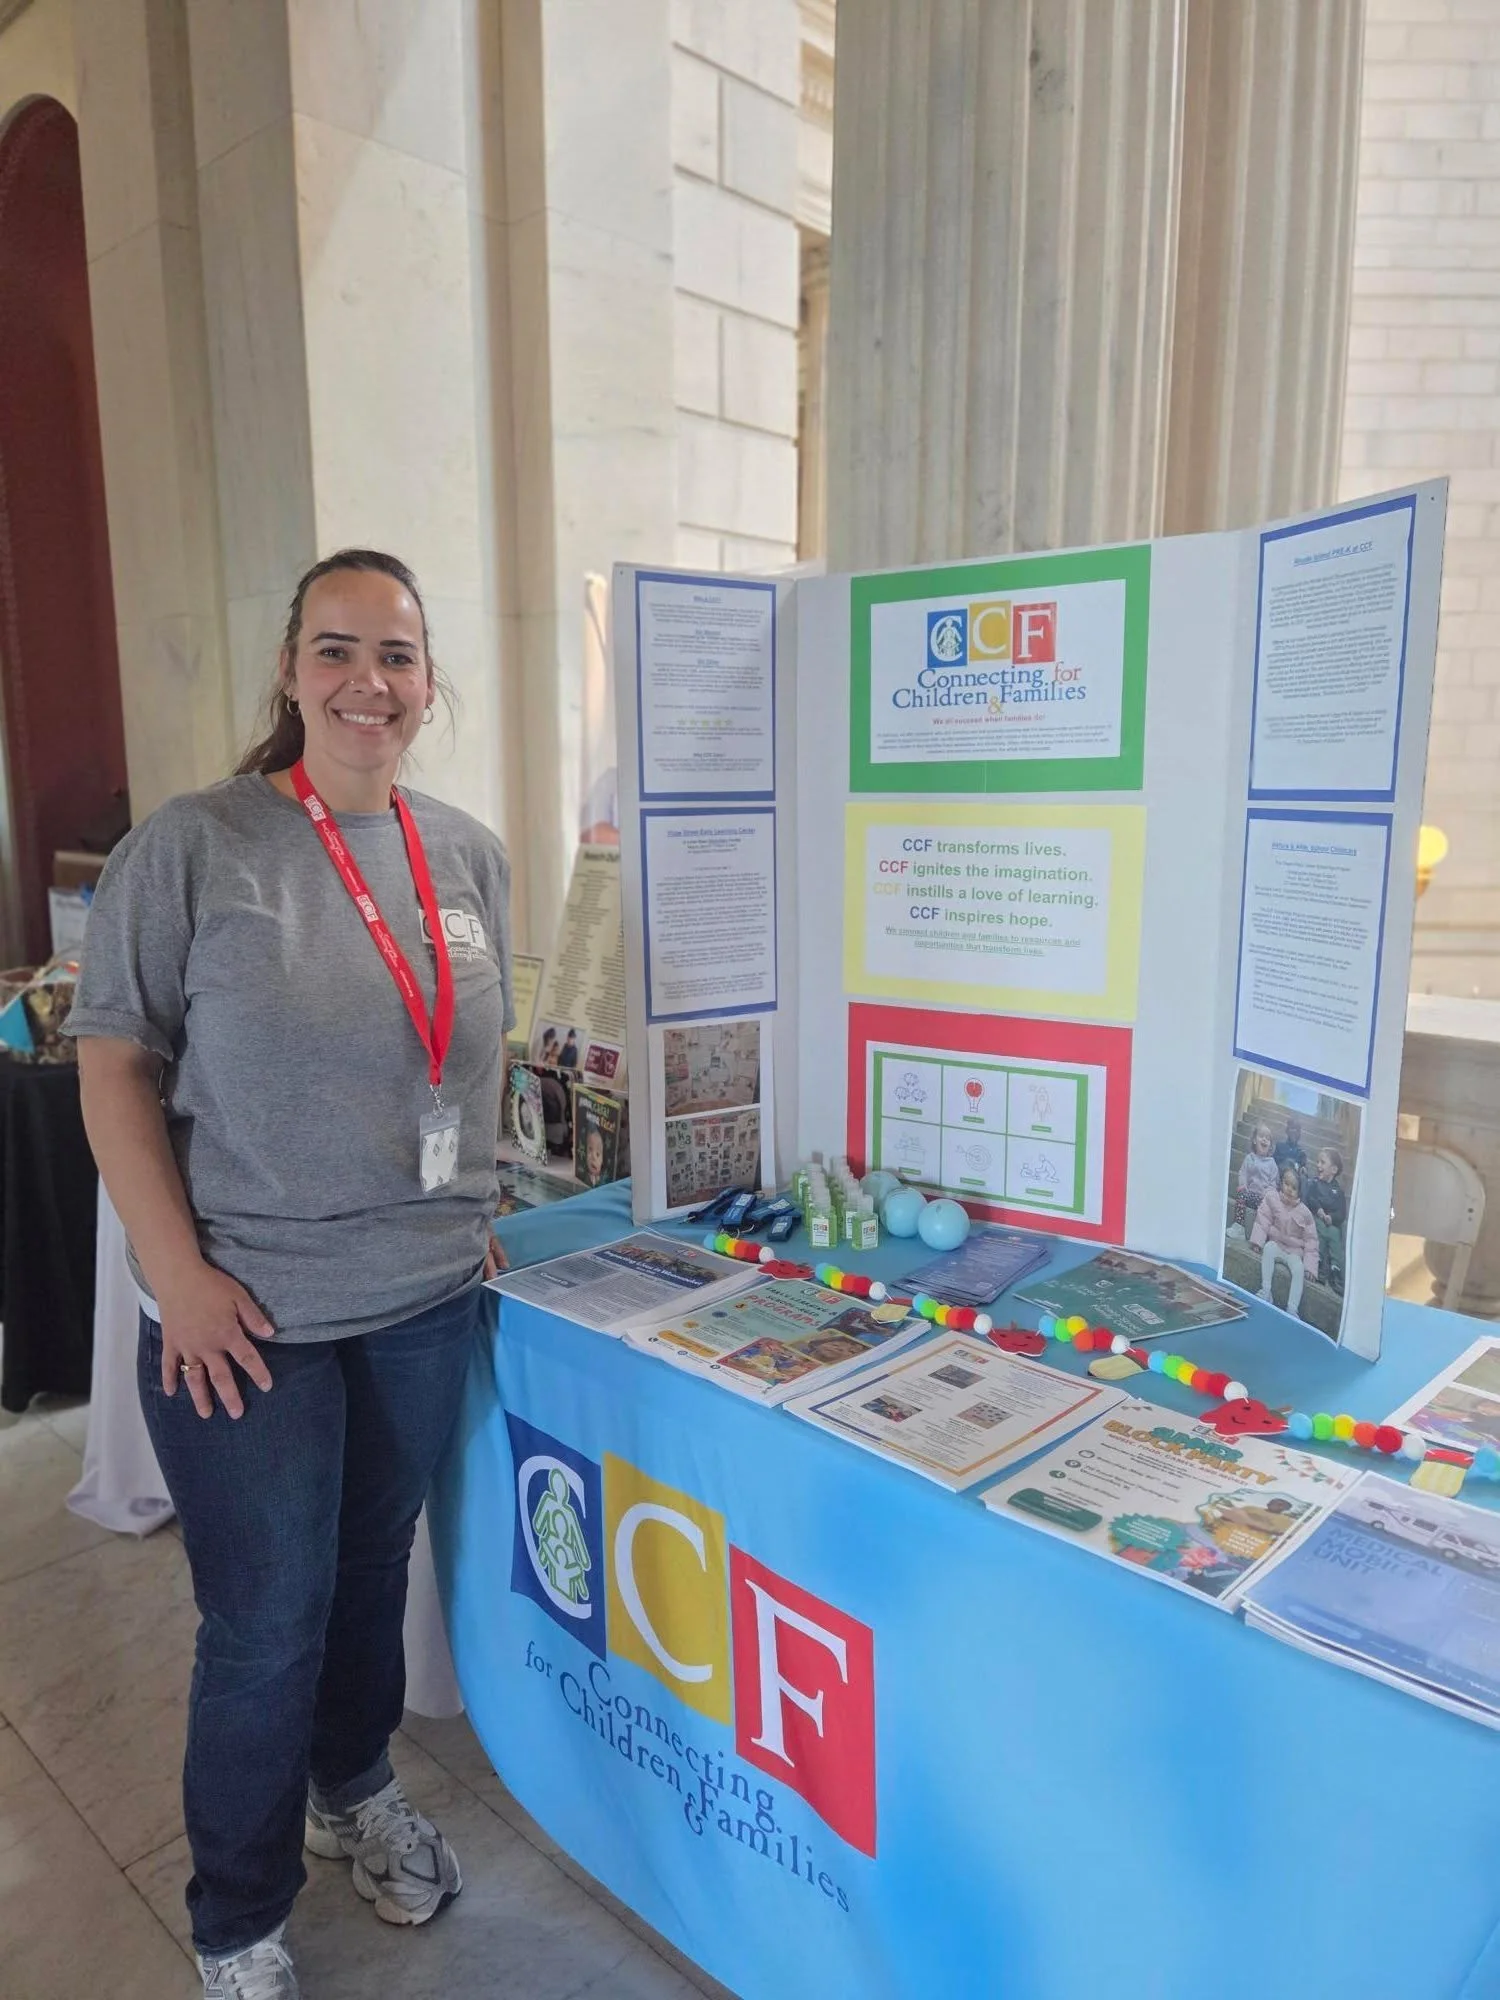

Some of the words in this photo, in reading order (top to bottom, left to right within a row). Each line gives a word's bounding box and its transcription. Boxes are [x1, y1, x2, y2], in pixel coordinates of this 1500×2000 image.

[930, 607, 1053, 662] CCF
[917, 665, 1044, 690] Connecting
[1053, 661, 1082, 683] for
[892, 686, 988, 709] Children
[988, 697, 1005, 715] &
[1000, 682, 1087, 704] Families
[902, 838, 933, 852] CCF
[937, 841, 1020, 855] transforms
[1025, 842, 1067, 857] lives.
[879, 860, 909, 873] CCF
[912, 861, 962, 877] ignites
[966, 864, 990, 877] the
[994, 864, 1093, 882] imagination.
[873, 882, 902, 895] CCF
[906, 884, 954, 899] instills
[958, 889, 967, 900] a
[971, 887, 1003, 901] love
[1008, 889, 1025, 902] of
[1028, 890, 1099, 909] learning.
[910, 906, 940, 920] CCF
[944, 909, 1004, 925] inspires
[1009, 910, 1053, 928] hope.
[885, 926, 897, 935] We
[930, 929, 960, 938] children
[962, 931, 976, 939] and
[978, 932, 1009, 942] families
[1011, 934, 1020, 942] to
[1022, 936, 1062, 945] resources
[1065, 938, 1081, 947] and
[914, 940, 964, 950] opportunities
[966, 941, 981, 950] that
[983, 943, 1022, 953] transform
[748, 1293, 822, 1328] PROGRAMS
[1103, 1420, 1182, 1456] BLOCK
[1184, 1448, 1278, 1486] PARTY
[1312, 1547, 1375, 1576] UNIT
[1328, 1527, 1444, 1577] MEDICAL
[518, 1455, 848, 1768] CCF
[588, 1661, 774, 1833] Connecting
[525, 1641, 553, 1678] for
[560, 1671, 683, 1794] Children
[698, 1780, 850, 1913] Families
